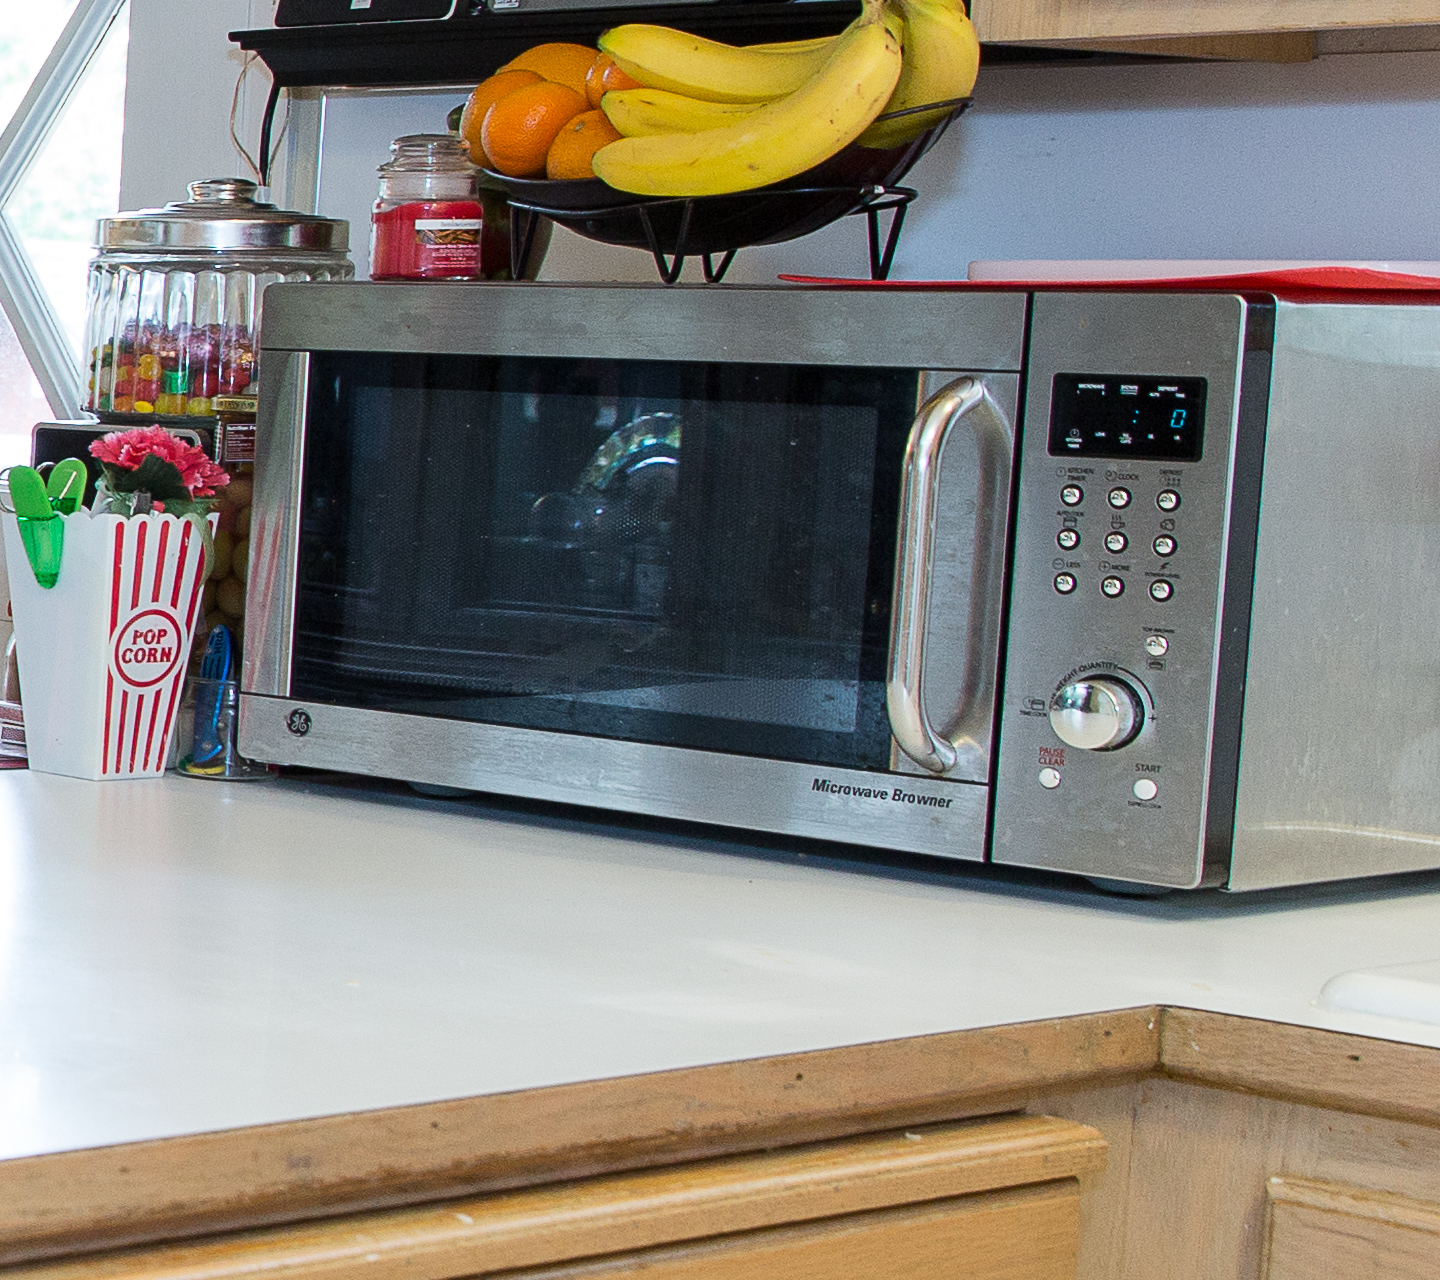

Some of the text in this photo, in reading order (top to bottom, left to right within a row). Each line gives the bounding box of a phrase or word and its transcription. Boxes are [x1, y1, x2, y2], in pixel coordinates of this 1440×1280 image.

[132, 628, 168, 645] POP
[121, 646, 173, 663] CORN
[1079, 661, 1118, 673] QUANTITY
[1039, 746, 1065, 757] PAUSE
[1038, 756, 1065, 766] CLEAR
[1135, 763, 1161, 773] START
[811, 778, 953, 808] Microwave Browner
